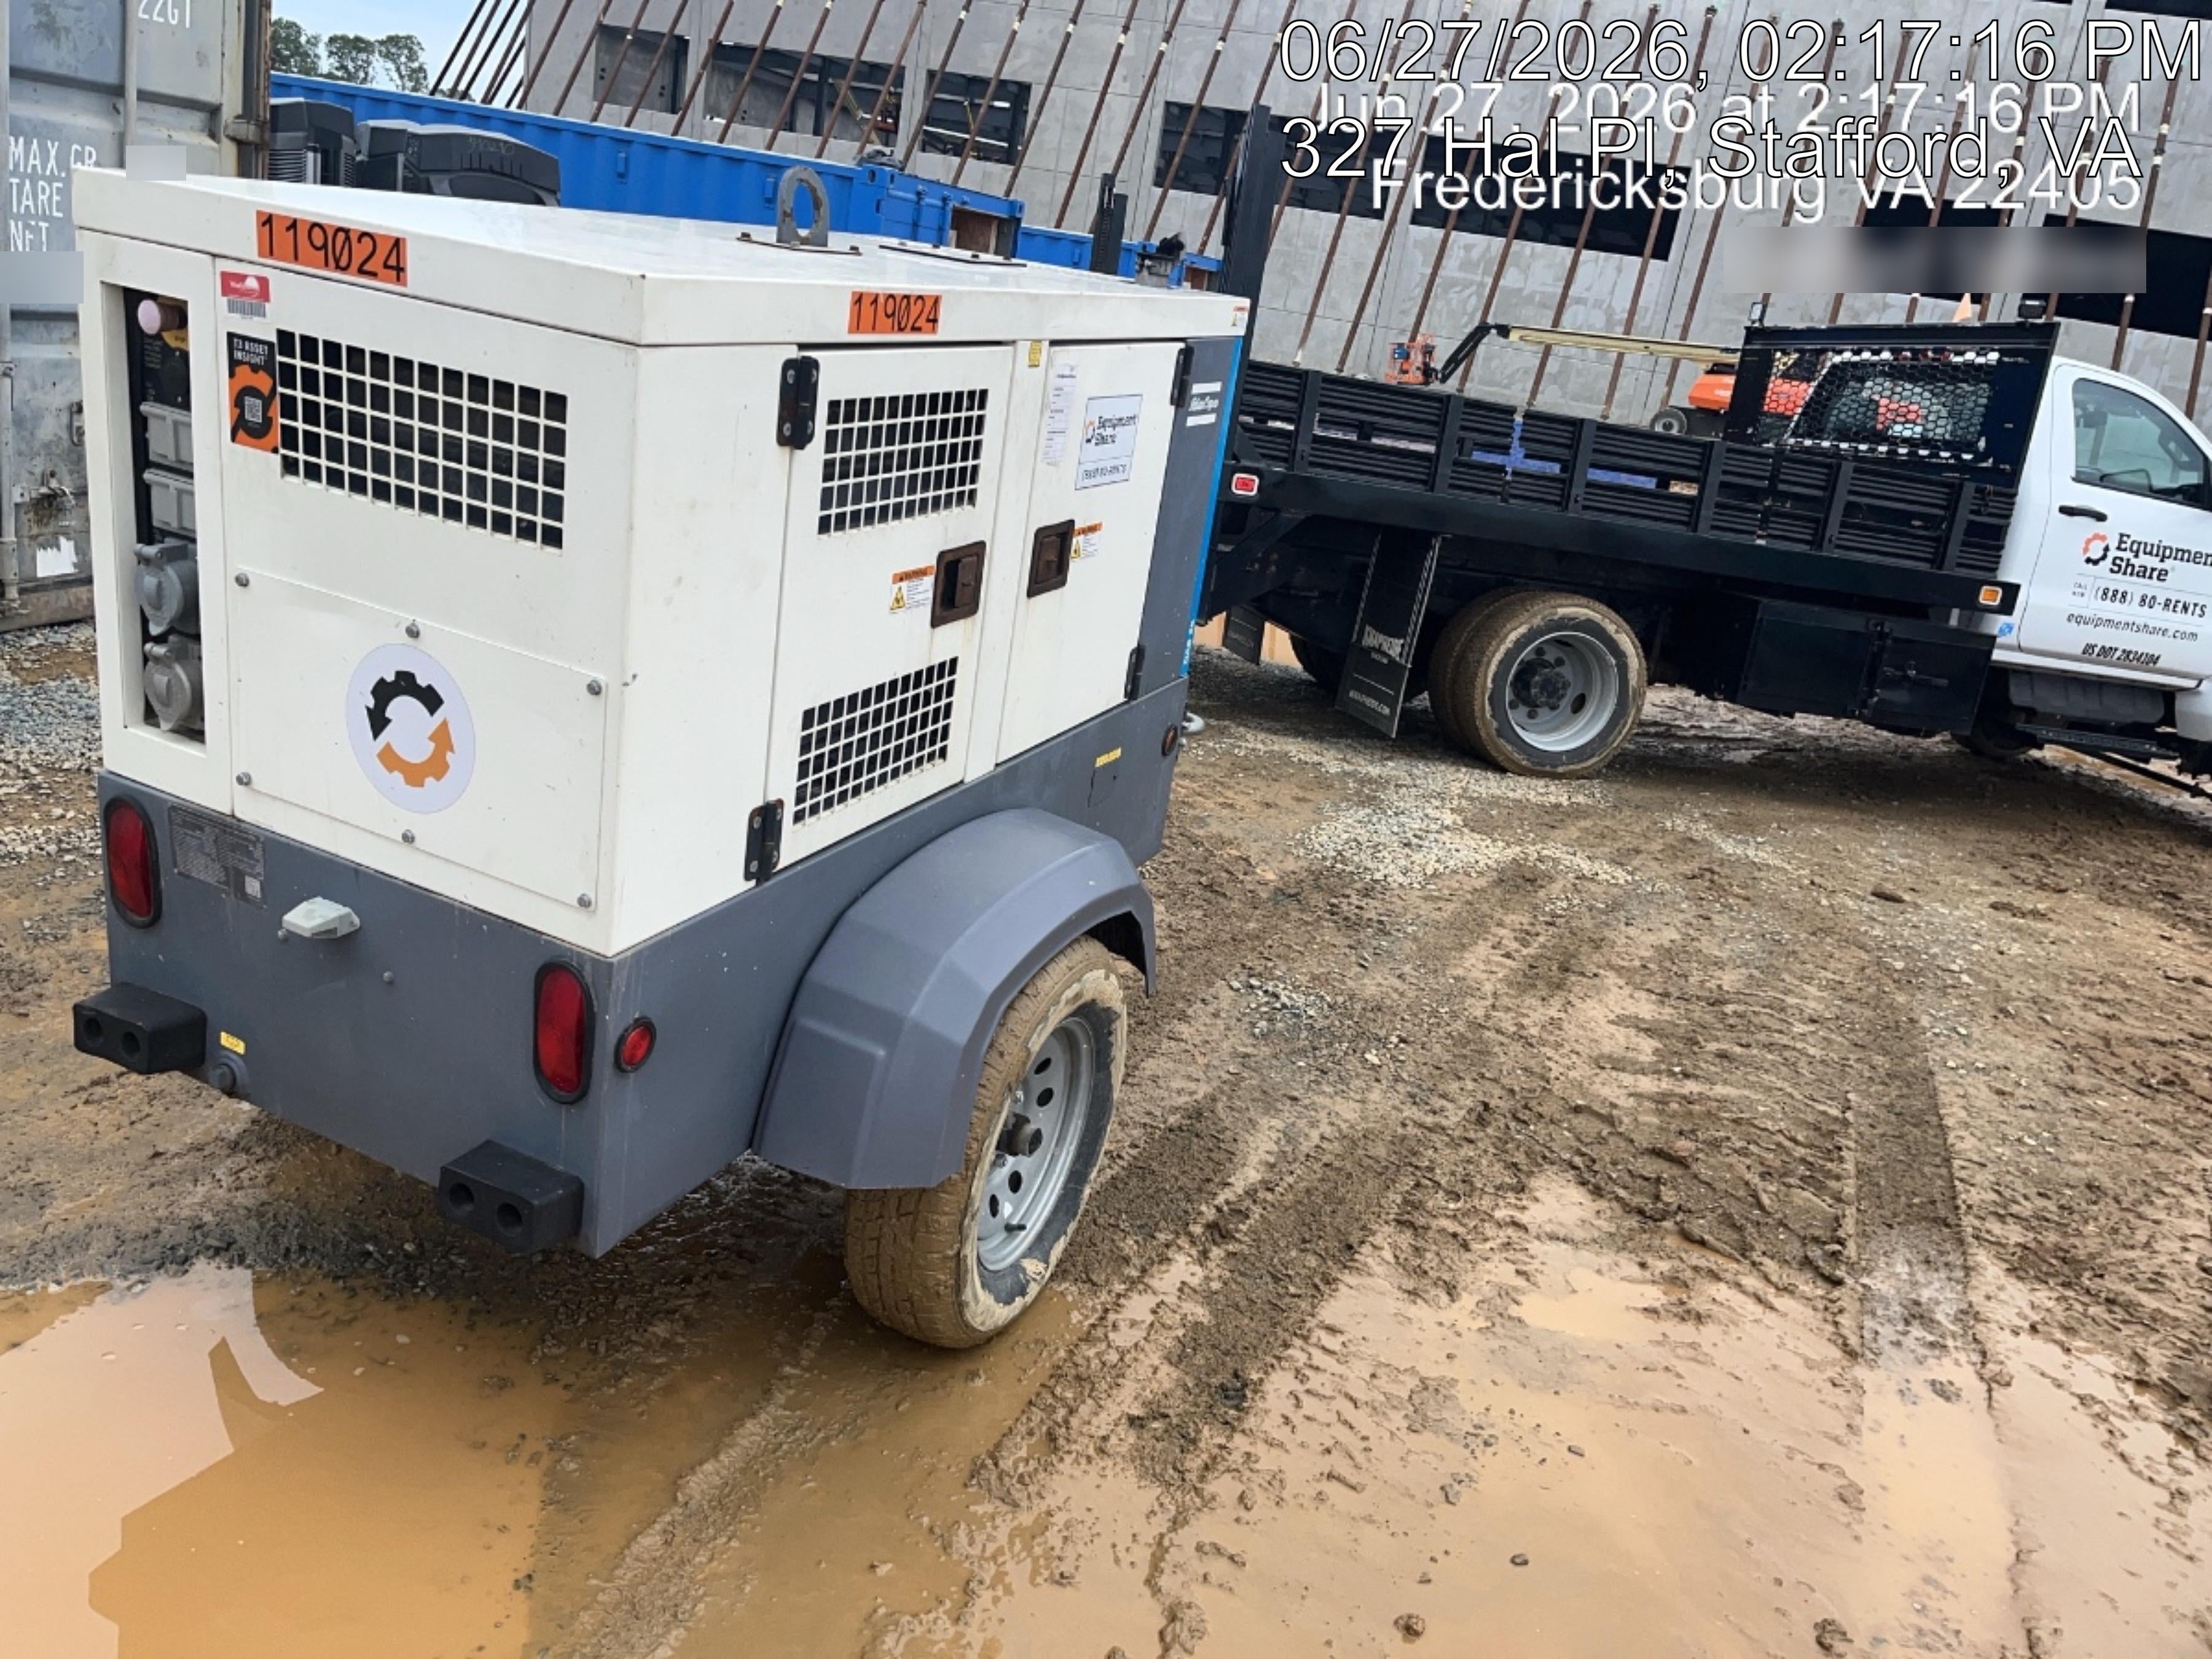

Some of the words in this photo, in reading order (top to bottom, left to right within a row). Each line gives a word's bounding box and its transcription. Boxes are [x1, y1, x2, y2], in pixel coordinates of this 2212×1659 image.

[9, 136, 66, 178] MAX.
[9, 178, 64, 218] TARE
[10, 219, 50, 251] NET
[261, 213, 405, 283] 119024
[853, 292, 939, 332] 119024
[2109, 555, 2169, 582] Share
[2094, 586, 2134, 607] (888)
[2138, 593, 2208, 619] 80-RENTS
[2066, 613, 2198, 642] equipmentshare.com
[2081, 643, 2098, 656] US
[2095, 645, 2119, 659] DOT
